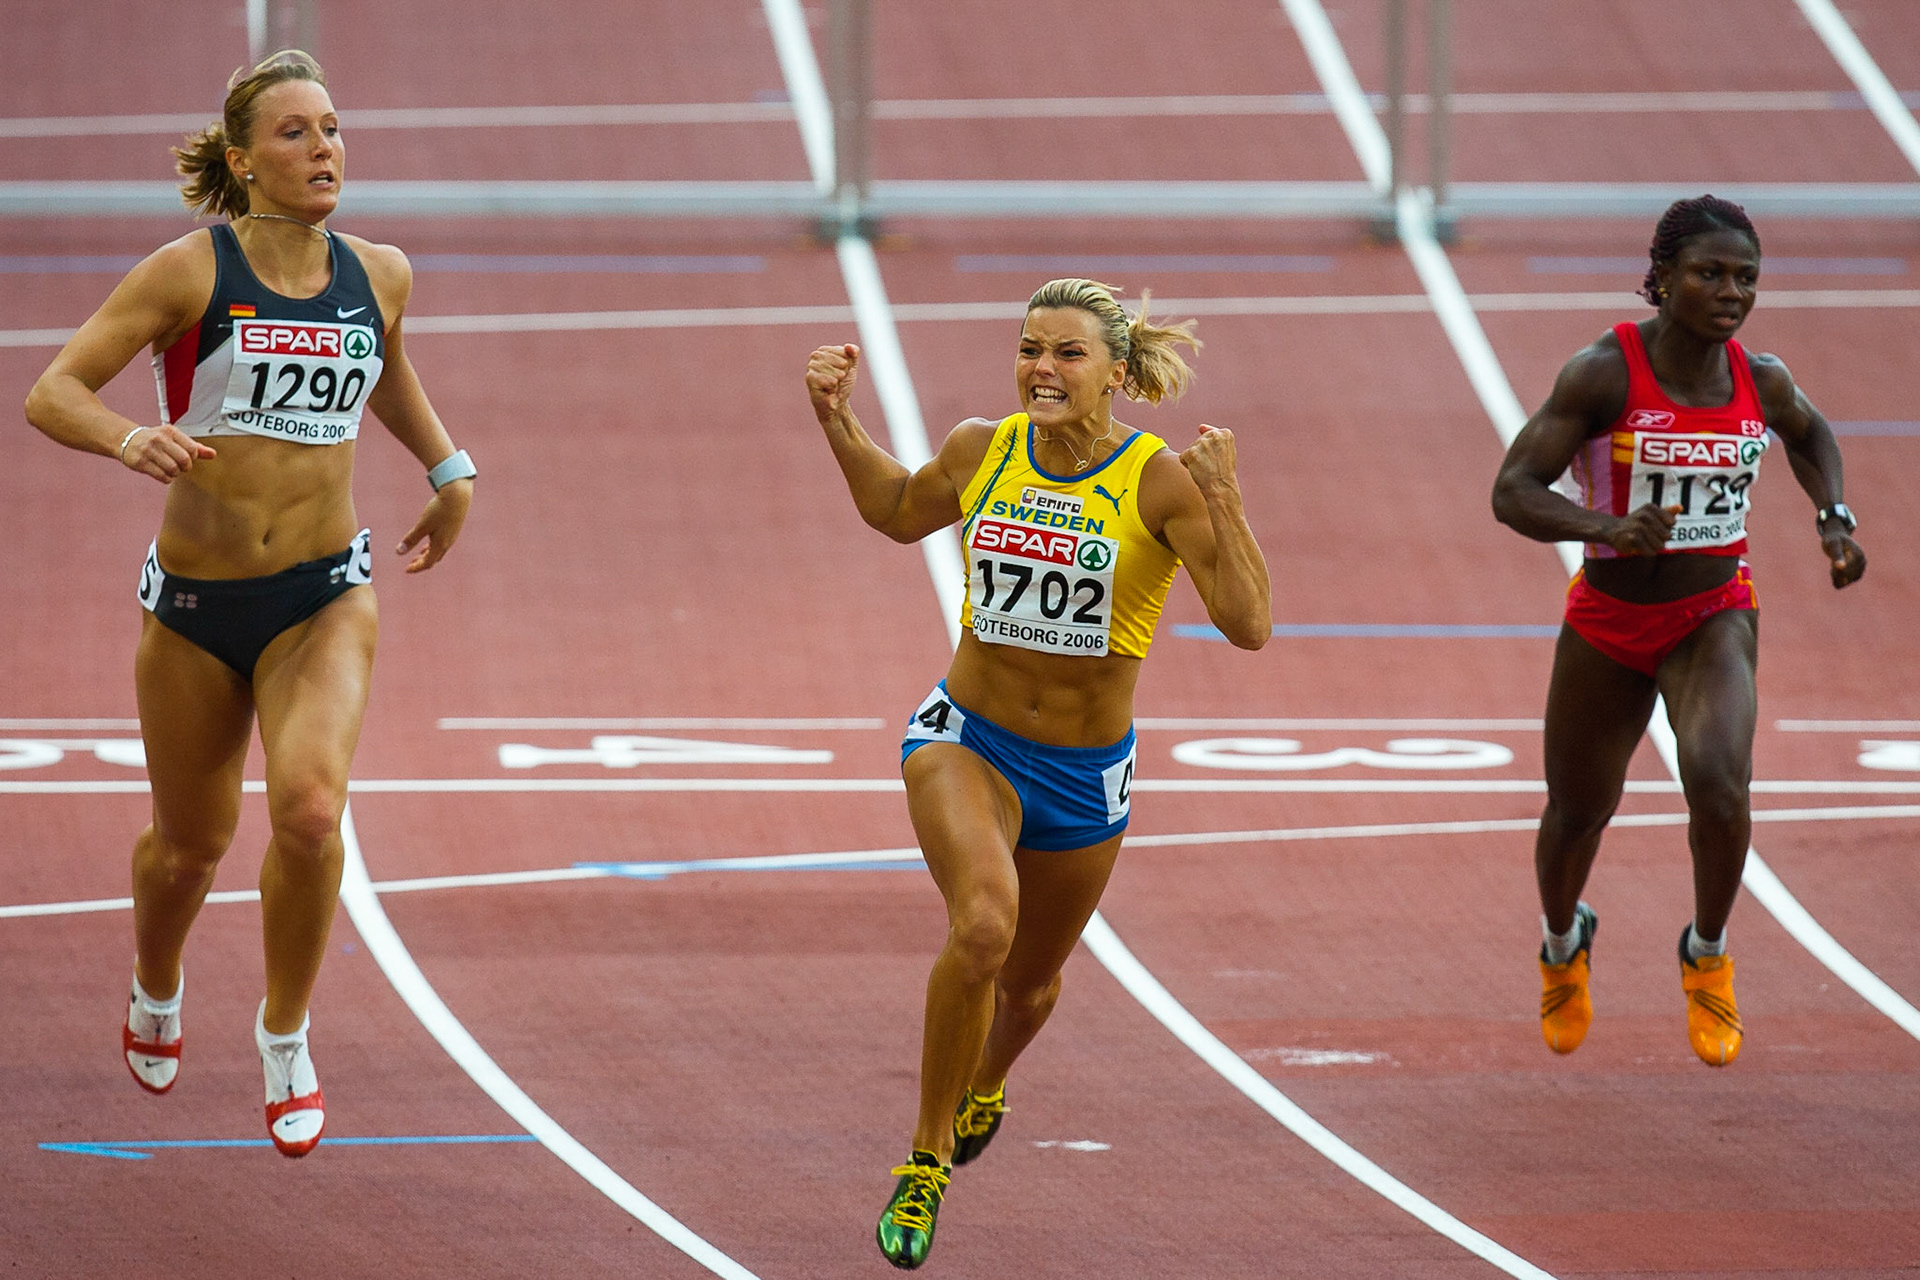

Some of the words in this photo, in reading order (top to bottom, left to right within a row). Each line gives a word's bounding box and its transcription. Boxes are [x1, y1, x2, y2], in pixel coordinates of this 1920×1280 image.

[244, 327, 339, 354] SPAR
[250, 362, 366, 413] 1290
[1644, 441, 1737, 465] SPAR
[1646, 471, 1754, 515] 1129
[990, 501, 1105, 535] SWEDEN
[976, 524, 1075, 562] SPAR
[977, 558, 1105, 625] 1702
[1063, 633, 1104, 649] 2006
[918, 699, 952, 734] 4
